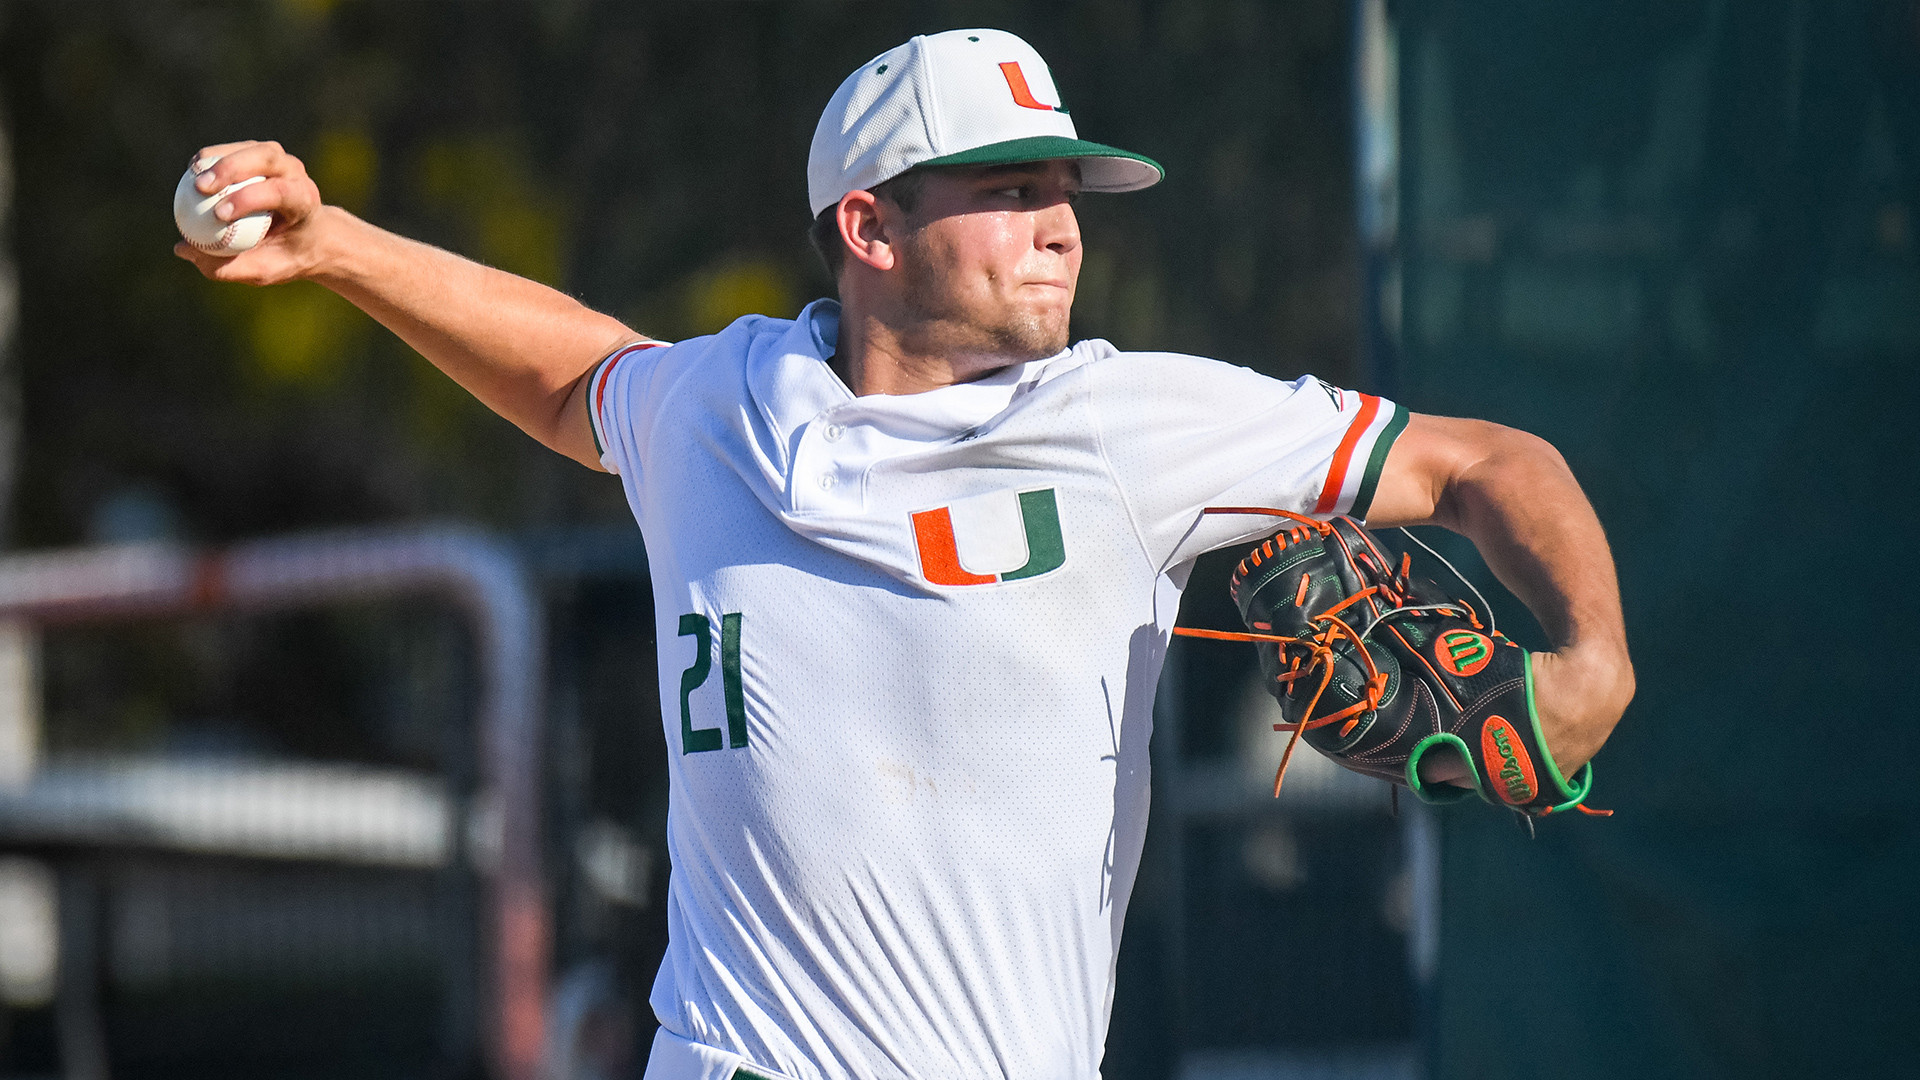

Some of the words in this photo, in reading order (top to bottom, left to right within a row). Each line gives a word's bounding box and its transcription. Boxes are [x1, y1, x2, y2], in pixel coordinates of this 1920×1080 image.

[999, 61, 1070, 114] U
[911, 487, 1067, 586] U
[678, 612, 749, 755] 21
[1492, 726, 1532, 802] Wilson
